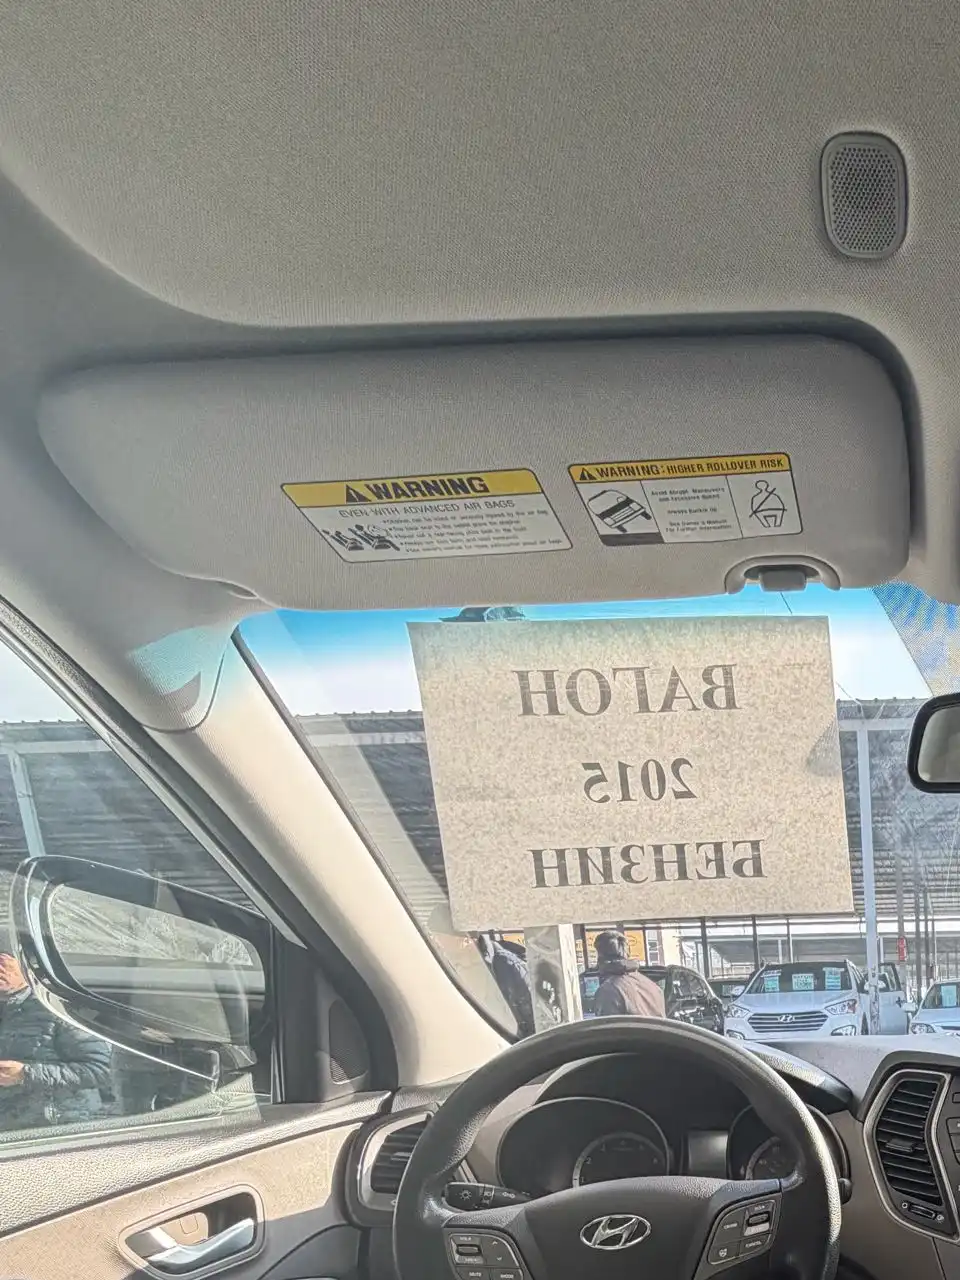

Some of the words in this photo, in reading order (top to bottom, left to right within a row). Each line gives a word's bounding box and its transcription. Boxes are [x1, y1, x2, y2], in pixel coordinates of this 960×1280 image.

[667, 463, 705, 474] HIGHER
[706, 461, 757, 472] ROLLOVER
[760, 459, 784, 468] RISK
[364, 477, 490, 500] WARNING
[339, 508, 369, 518] EVEN
[370, 506, 400, 516] WITH
[403, 503, 460, 514] ADVANCED
[464, 502, 482, 511] AIR
[485, 500, 516, 509] BAGS
